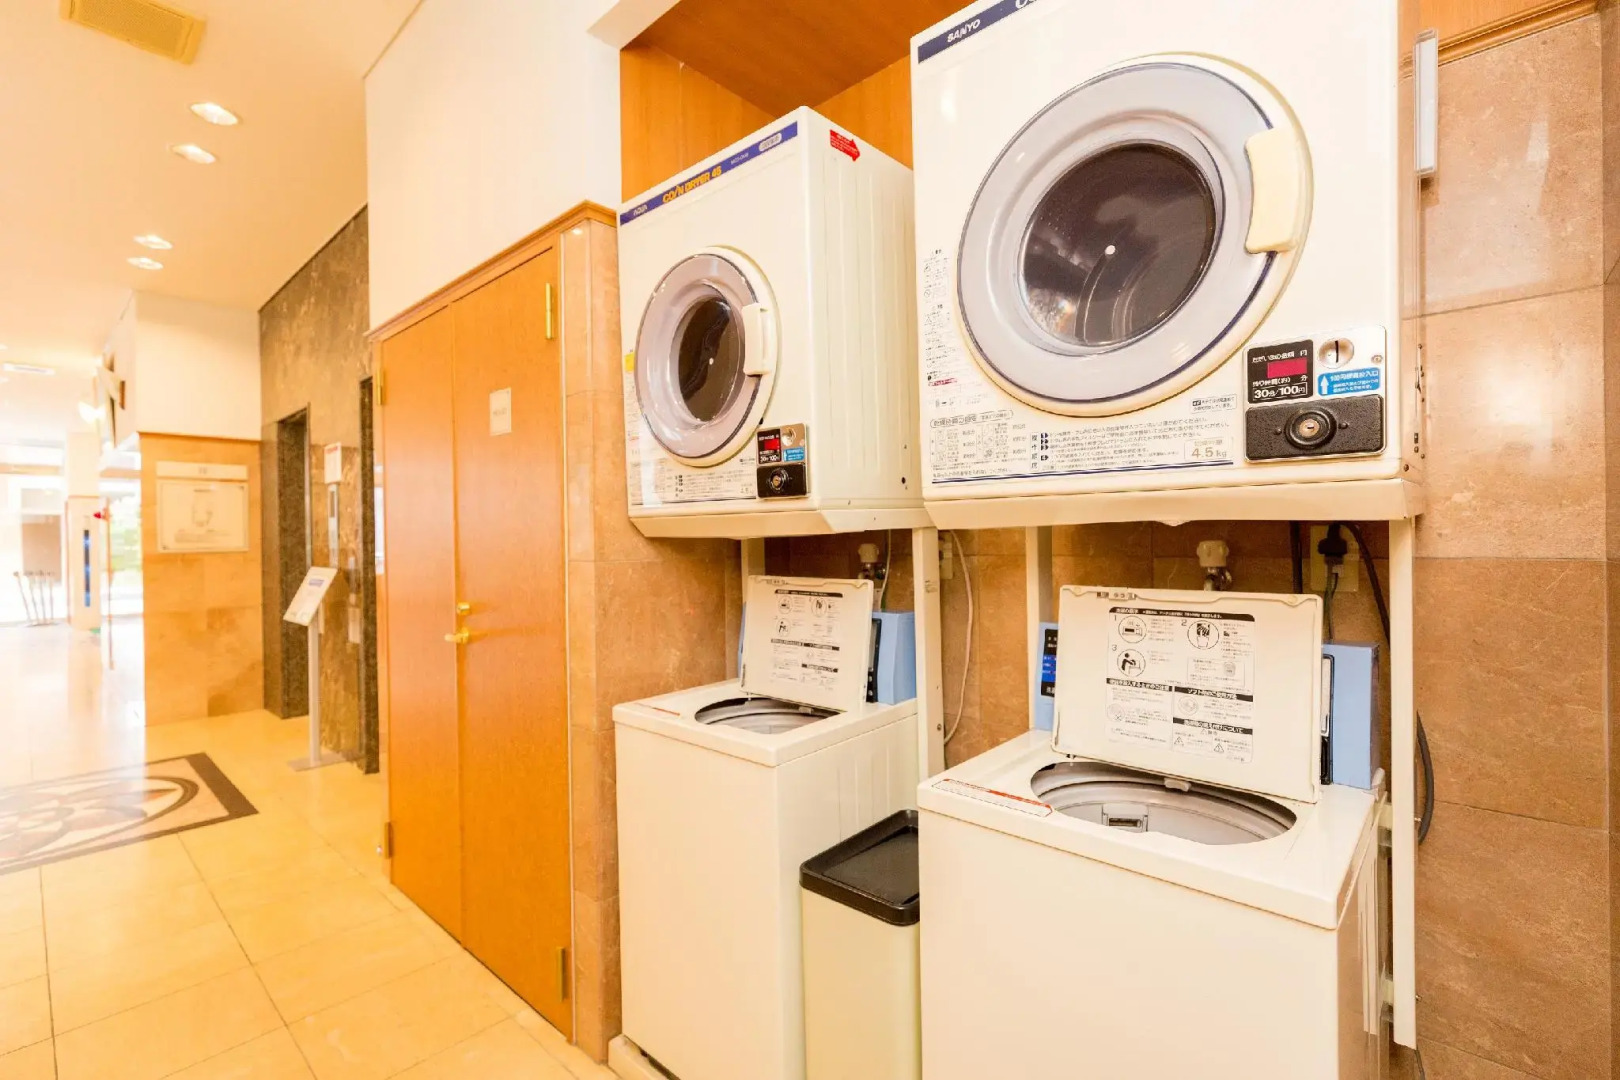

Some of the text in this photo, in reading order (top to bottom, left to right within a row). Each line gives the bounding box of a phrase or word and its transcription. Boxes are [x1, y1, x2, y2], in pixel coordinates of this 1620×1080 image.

[947, 18, 981, 43] SANYO
[662, 185, 684, 203] COIN
[684, 172, 710, 192] DRYER
[711, 166, 722, 178] 45
[1191, 446, 1227, 458] 4.5 kg
